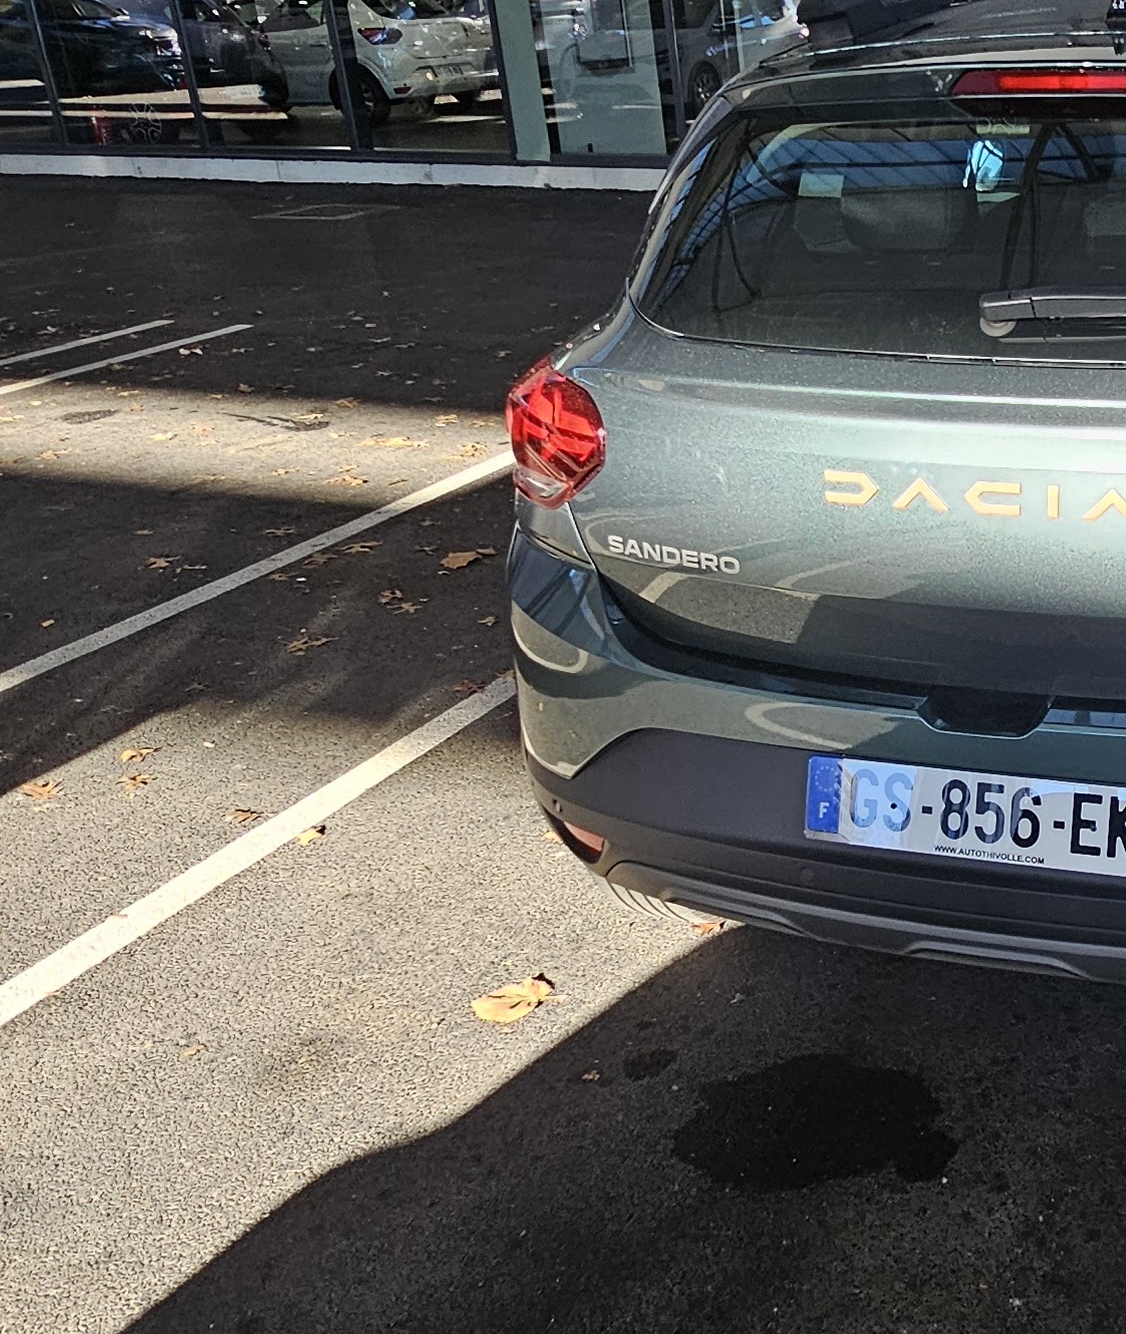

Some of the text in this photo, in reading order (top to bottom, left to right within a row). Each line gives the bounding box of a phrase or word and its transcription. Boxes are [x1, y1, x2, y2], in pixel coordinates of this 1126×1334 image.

[607, 534, 741, 575] SANDERO
[818, 801, 830, 819] F
[933, 844, 1046, 865] WWW.AUTOTHIVOLLE.COM
